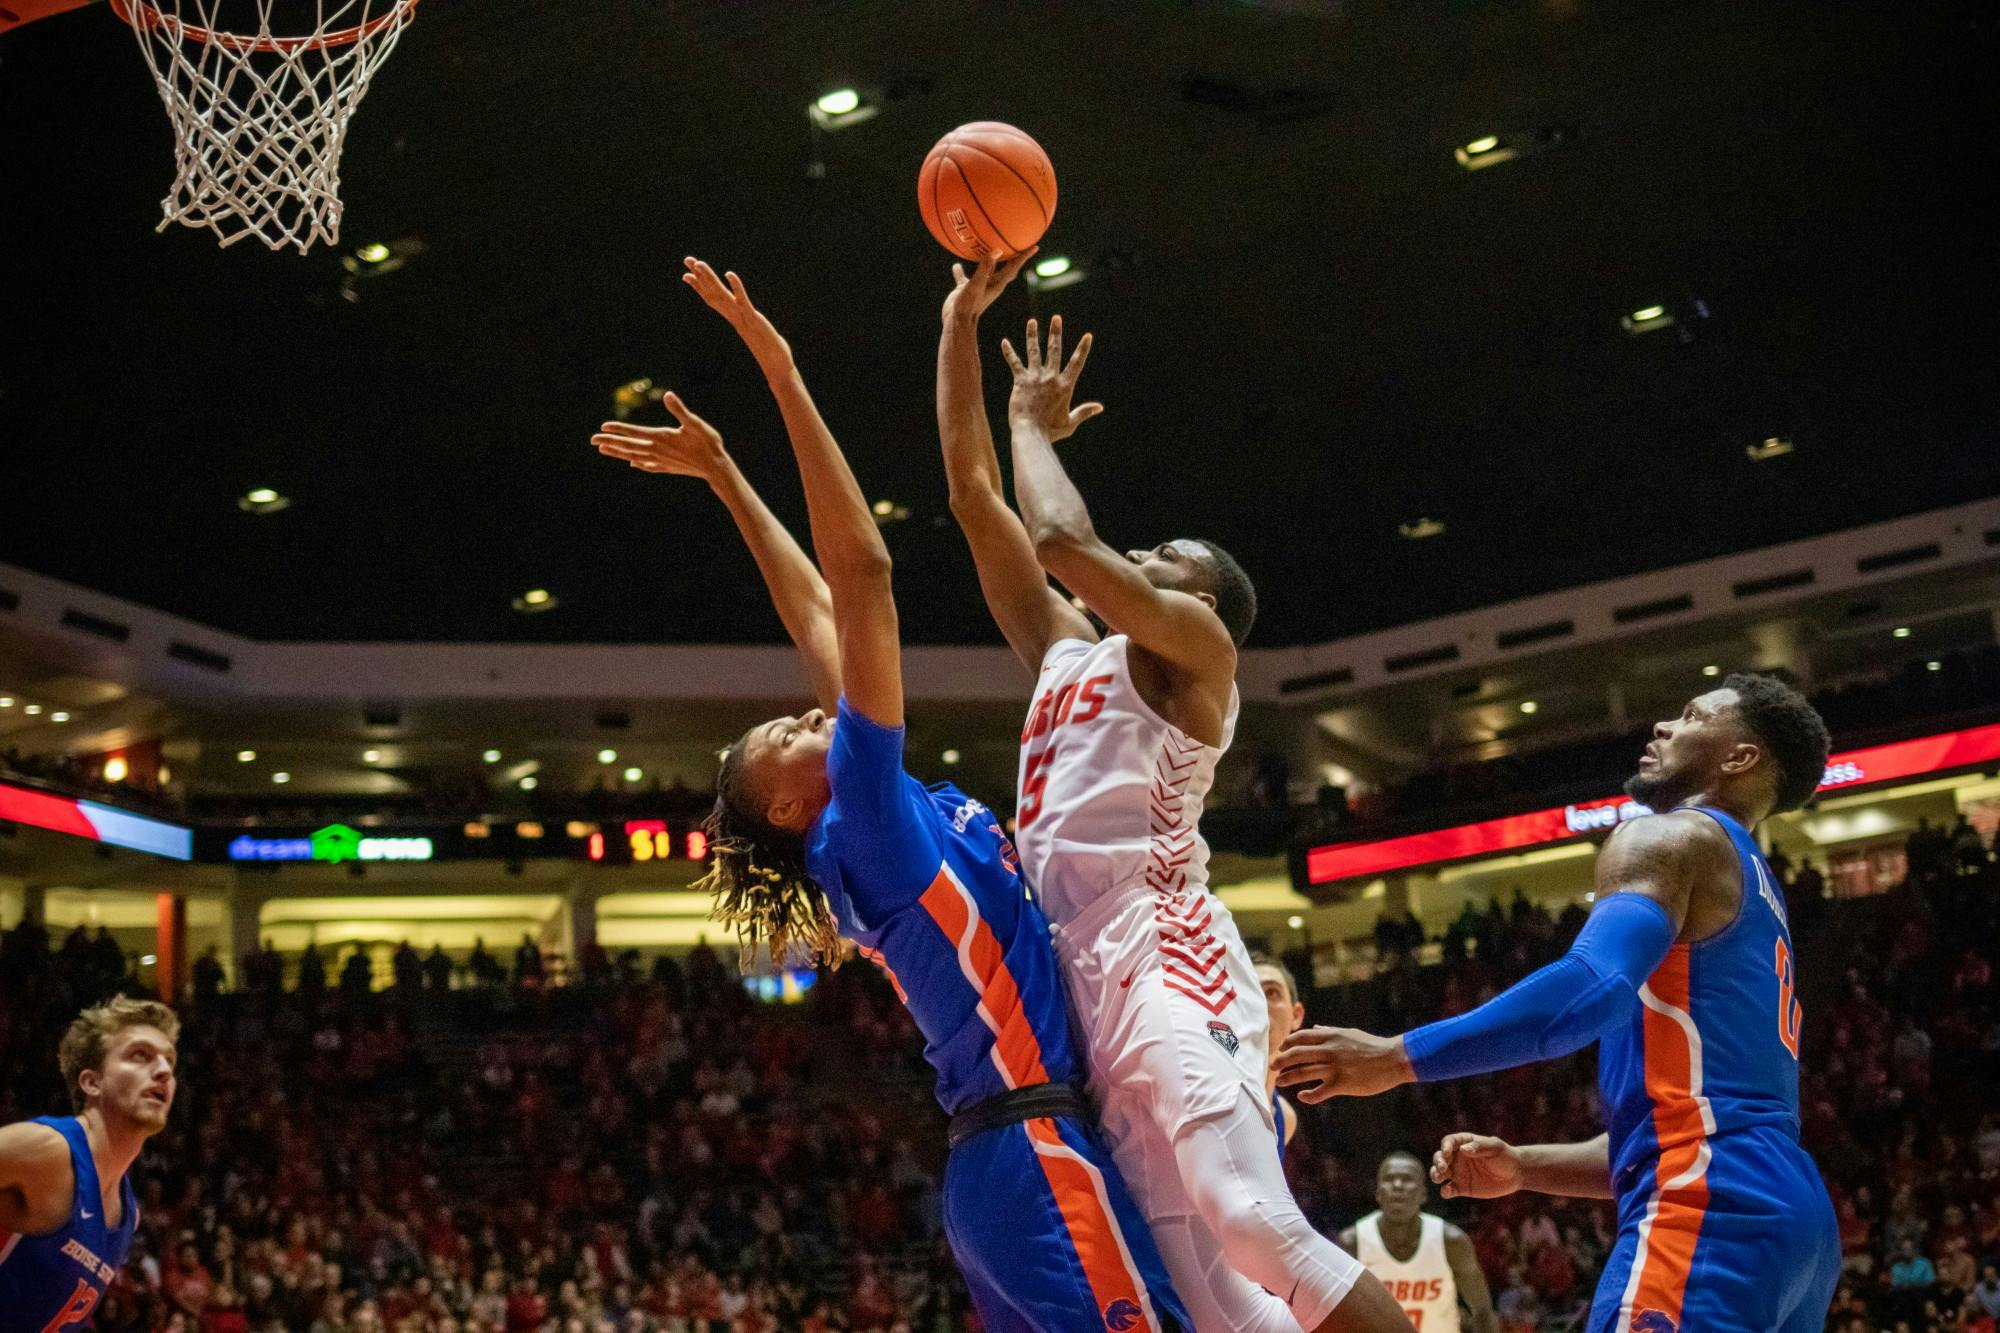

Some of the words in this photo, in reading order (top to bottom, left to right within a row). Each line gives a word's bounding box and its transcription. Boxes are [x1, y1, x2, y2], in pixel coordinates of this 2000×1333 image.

[1018, 744, 1057, 829] 5
[1565, 805, 1618, 832] love
[630, 829, 671, 861] 51
[61, 1238, 102, 1273] BOISE
